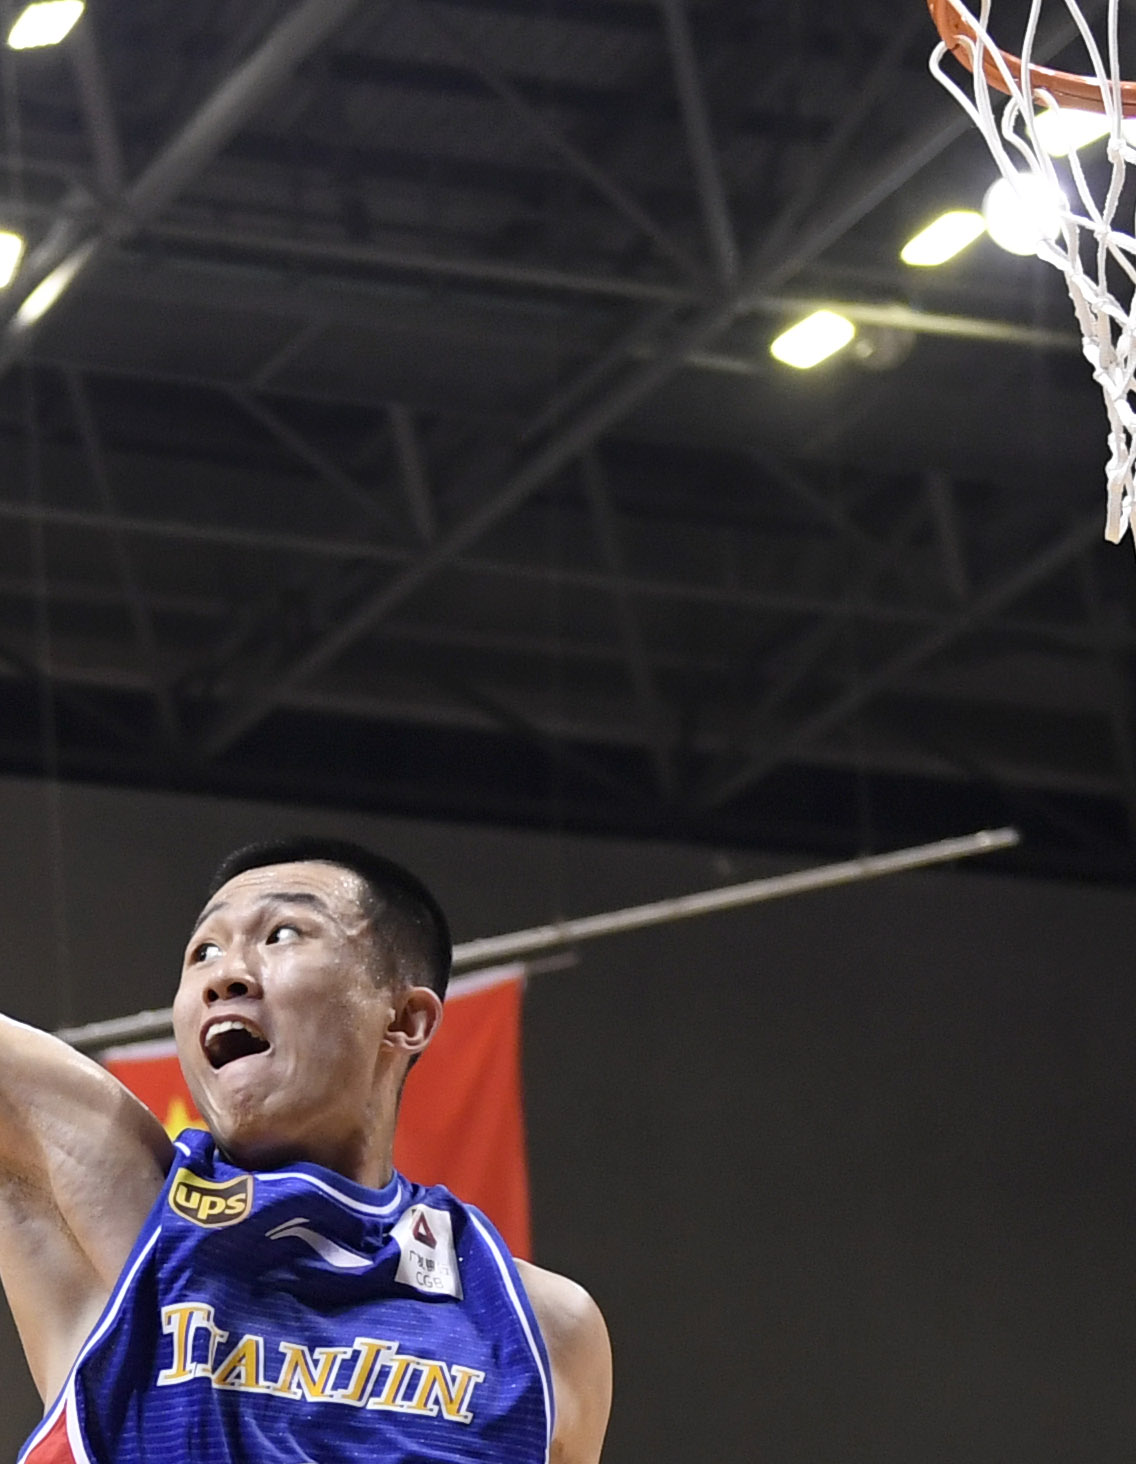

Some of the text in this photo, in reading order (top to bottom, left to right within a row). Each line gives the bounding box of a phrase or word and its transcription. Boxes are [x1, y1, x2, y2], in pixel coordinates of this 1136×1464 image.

[175, 1184, 246, 1220] ups
[416, 1271, 444, 1289] CGB
[157, 1303, 485, 1424] TIANJIN
